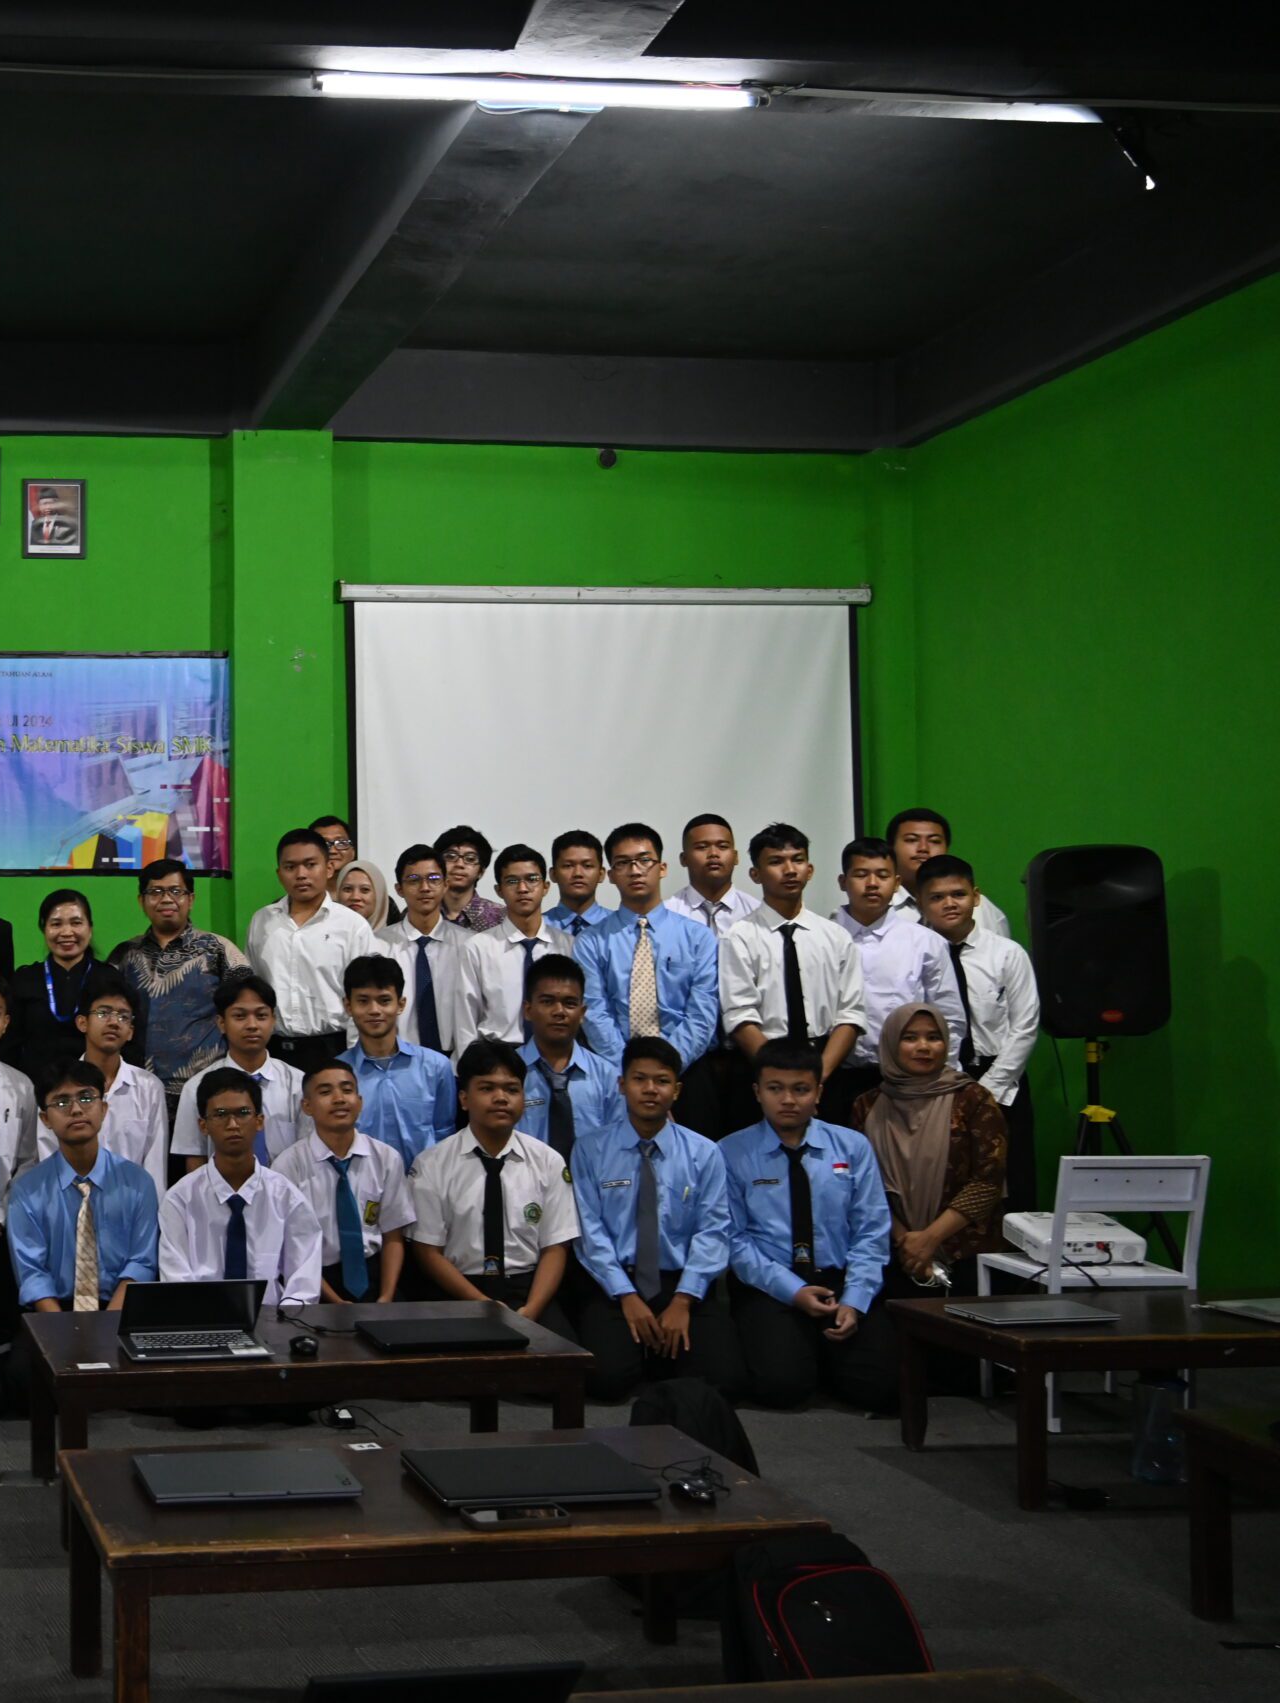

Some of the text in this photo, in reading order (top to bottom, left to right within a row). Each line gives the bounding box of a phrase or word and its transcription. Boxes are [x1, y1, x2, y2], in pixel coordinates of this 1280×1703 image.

[10, 733, 111, 753] Matematika
[116, 735, 166, 754] Siswa
[171, 735, 213, 754] SMK
